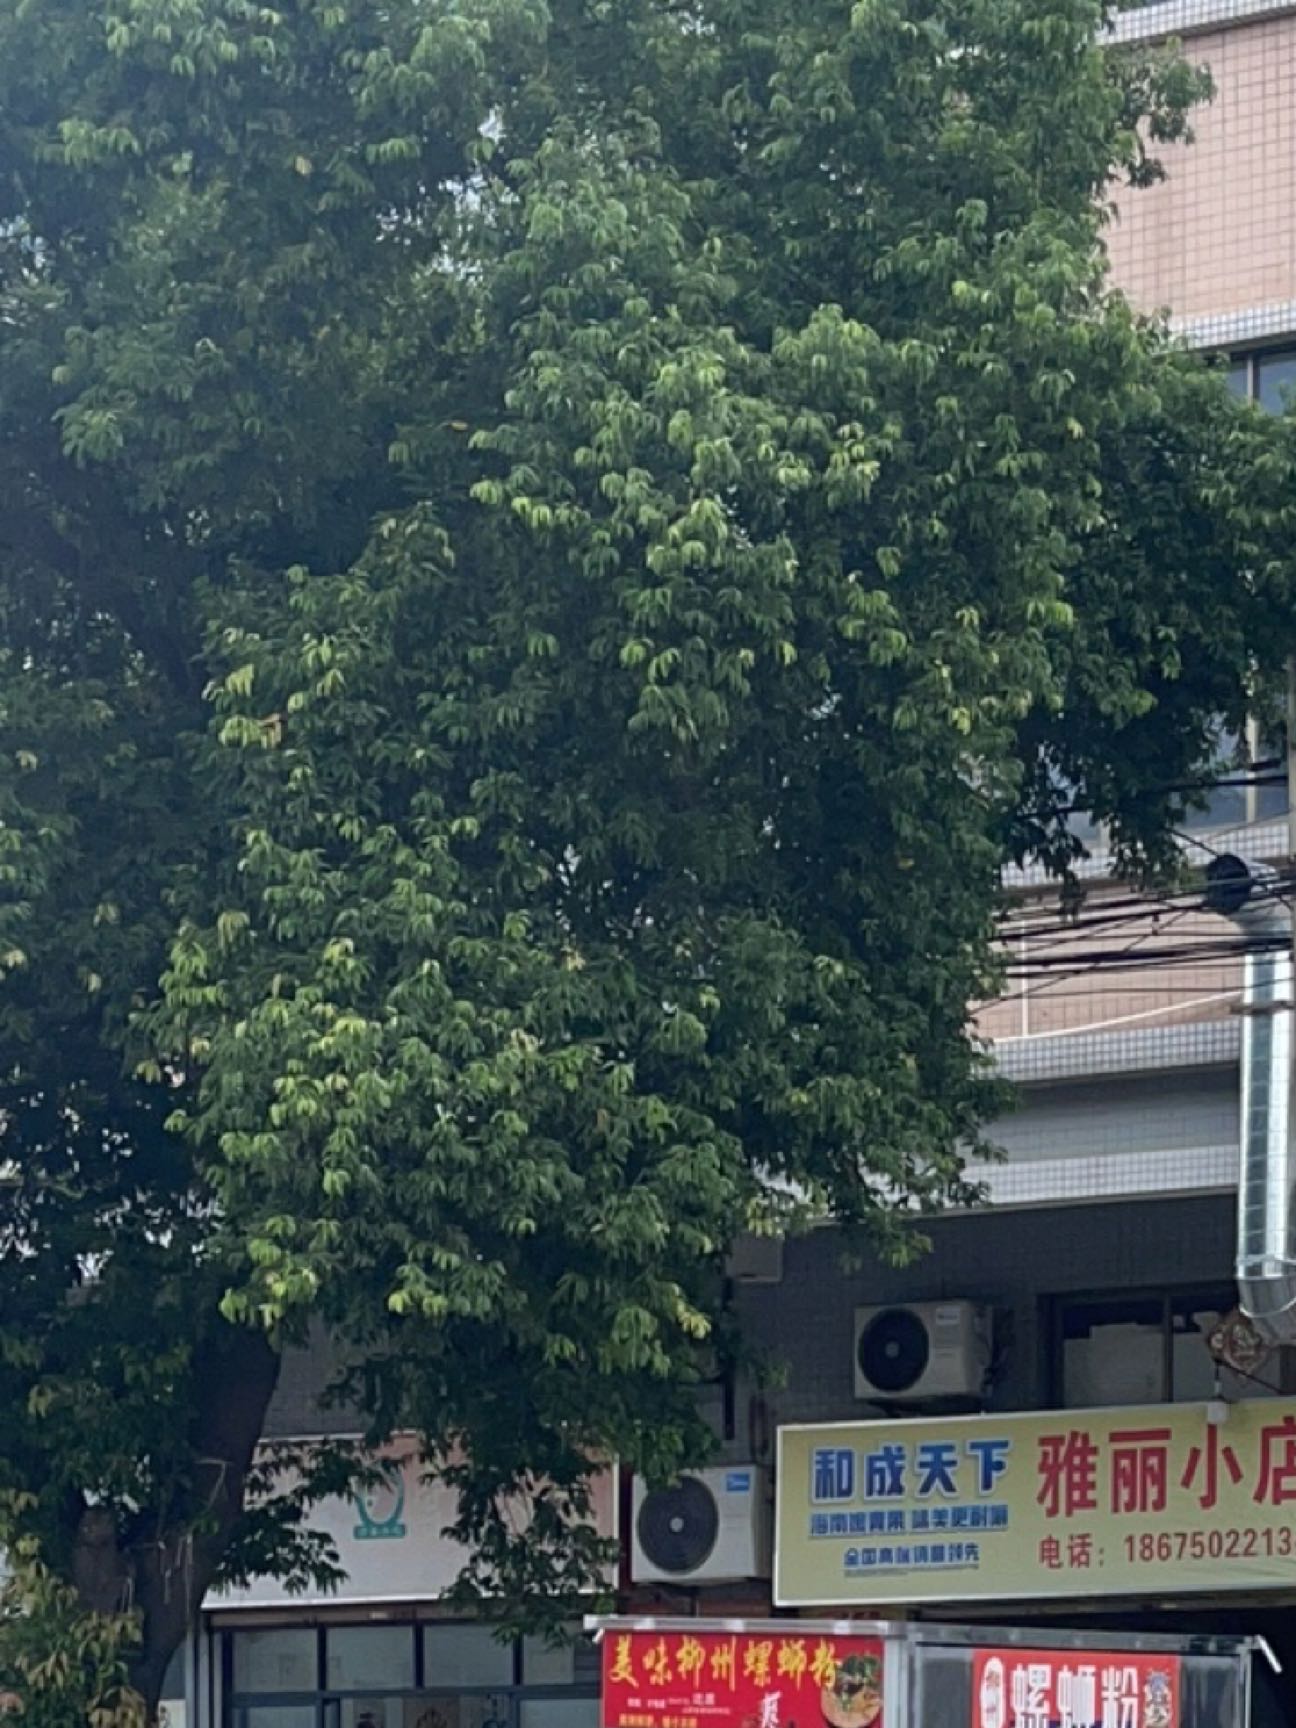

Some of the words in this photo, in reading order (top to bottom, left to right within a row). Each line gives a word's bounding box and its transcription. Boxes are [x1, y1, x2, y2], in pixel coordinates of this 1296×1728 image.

[812, 1440, 1009, 1499] 和成天下
[608, 1634, 838, 1691] 美味柳州螺蛳粉
